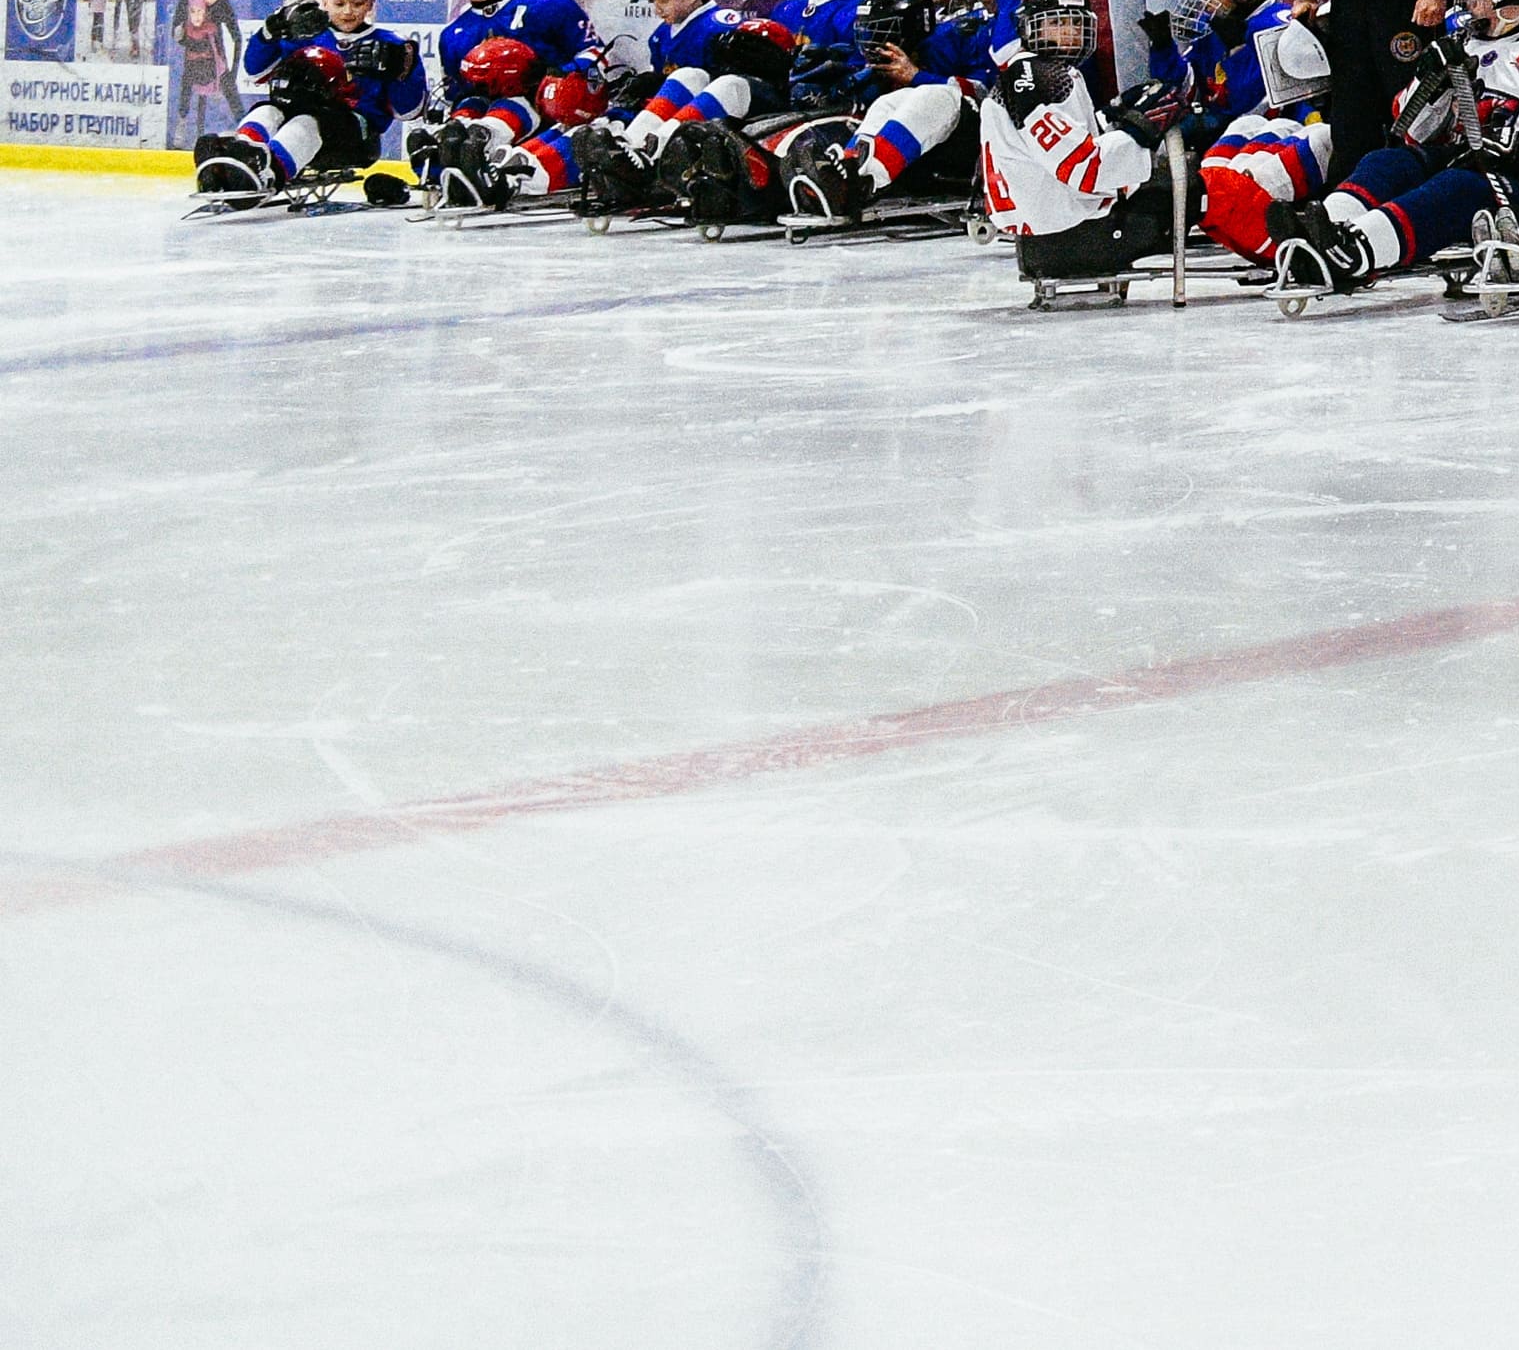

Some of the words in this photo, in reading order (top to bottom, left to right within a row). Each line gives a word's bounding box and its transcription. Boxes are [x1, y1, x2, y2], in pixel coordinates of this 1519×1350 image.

[10, 80, 90, 103] ФИГУРНОЕ
[94, 82, 163, 106] КАТАНИЕ
[8, 111, 60, 133] НАБОР
[64, 113, 75, 133] В
[78, 114, 140, 137] ГРУППЫ
